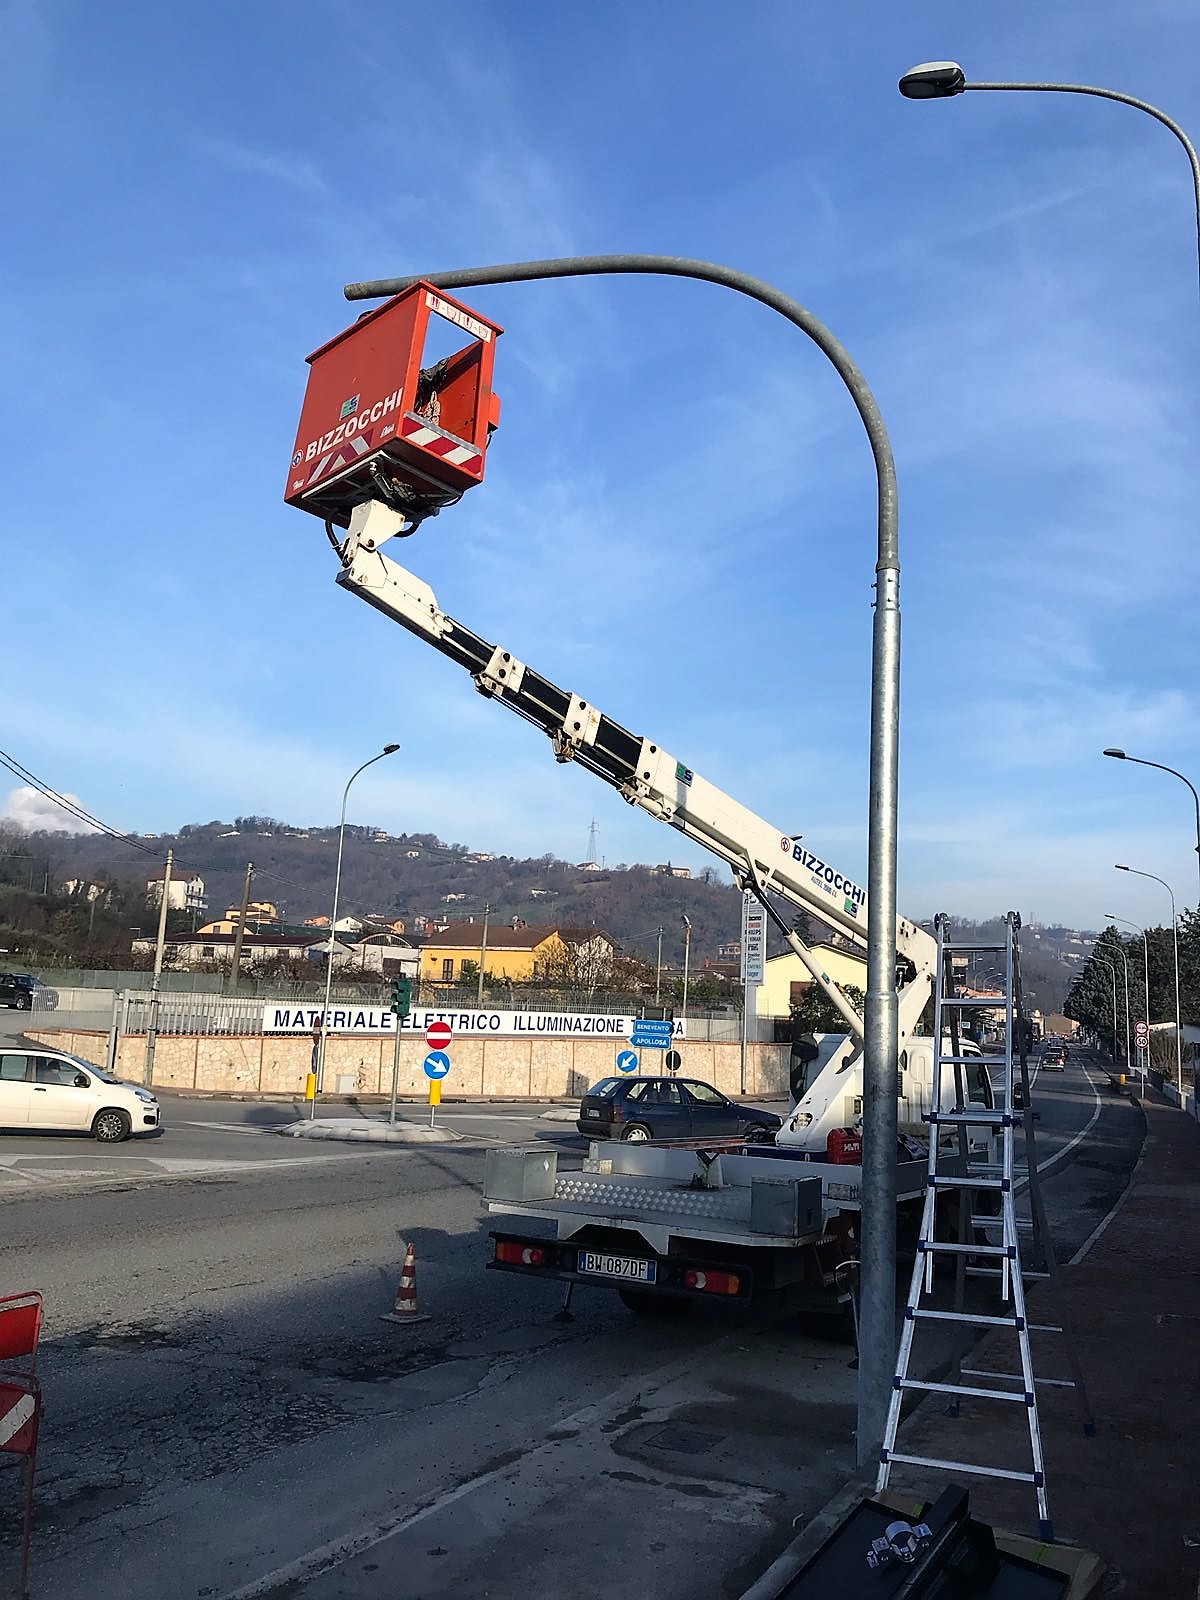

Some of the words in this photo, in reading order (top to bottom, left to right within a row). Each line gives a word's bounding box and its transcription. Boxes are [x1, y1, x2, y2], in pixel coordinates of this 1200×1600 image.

[305, 387, 404, 462] BIZZOCCHI
[792, 843, 866, 906] BIZZOCCHI
[274, 1010, 391, 1028] MATERIALE
[400, 1013, 500, 1030] ELETTRICO
[513, 1015, 624, 1033] ILLUMINAZIONE
[636, 1024, 670, 1032] BENEVENTO
[636, 1037, 667, 1045] APOLLOSA
